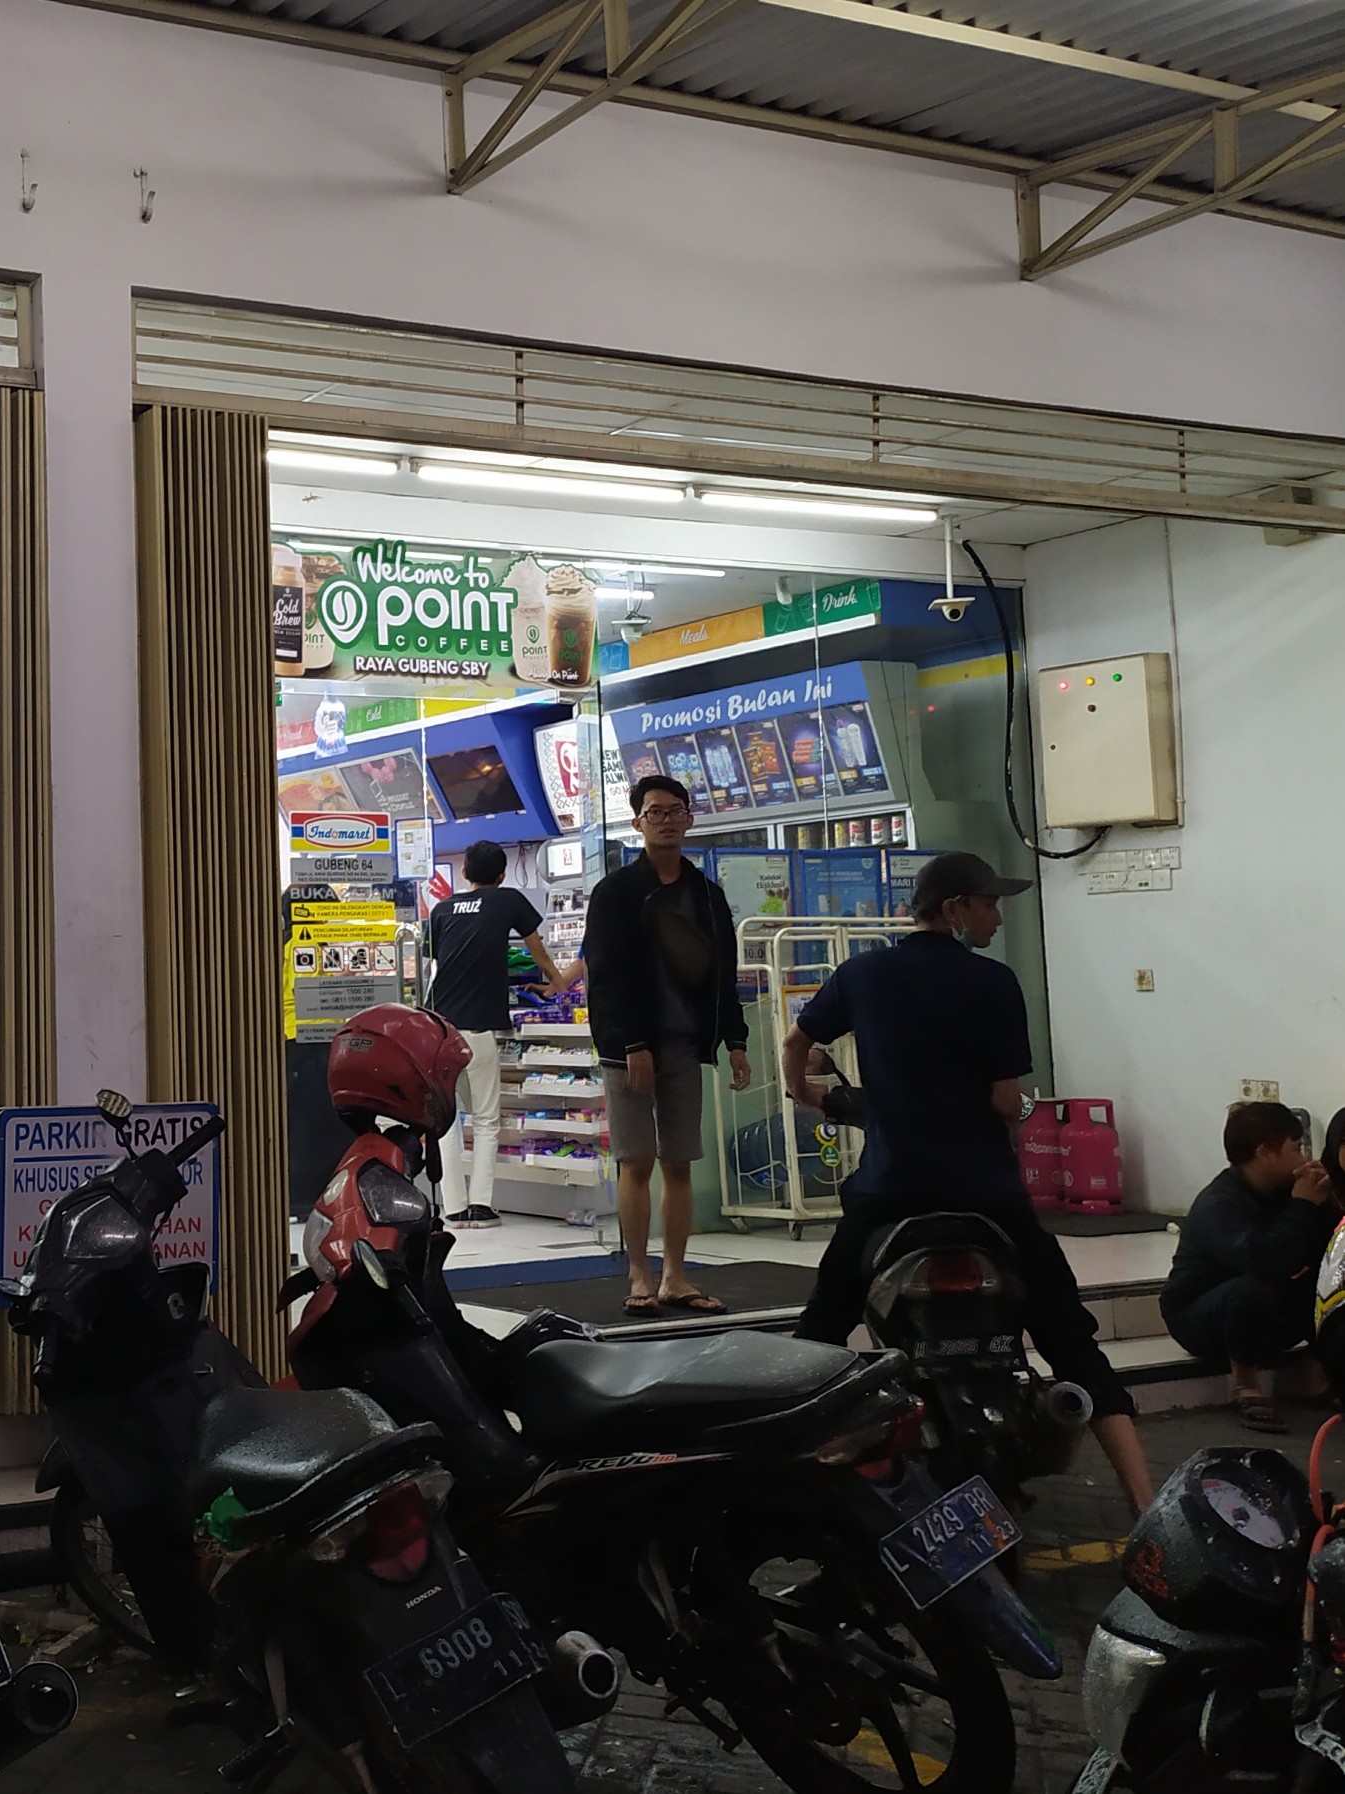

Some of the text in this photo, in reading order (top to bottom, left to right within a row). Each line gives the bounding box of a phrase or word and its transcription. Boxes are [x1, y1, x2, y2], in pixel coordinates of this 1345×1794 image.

[357, 544, 490, 588] Welcome to
[276, 599, 299, 614] Cold
[822, 586, 858, 612] Drink
[273, 611, 302, 626] Brew
[377, 586, 514, 645] POINT
[305, 633, 325, 644] OINT
[679, 624, 709, 646] Meals
[396, 636, 509, 652] COFFEE
[522, 645, 548, 658] POINT
[355, 655, 489, 676] RAYA GUBENG SBY
[552, 670, 561, 679] On
[562, 668, 580, 680] Point
[640, 675, 833, 734] Promosi Bulan Ini
[365, 706, 383, 722] Cold
[309, 825, 371, 841] Indomaret
[314, 858, 373, 871] GUBENG 64
[290, 887, 336, 900] BUKA
[349, 1038, 373, 1047] GP
[13, 1166, 79, 1194] KHUSUS
[576, 1453, 651, 1472] REVO
[883, 1547, 910, 1574] L
[912, 1505, 964, 1553] 2429
[405, 1585, 443, 1609] HONDA
[418, 1617, 493, 1678] 6908
